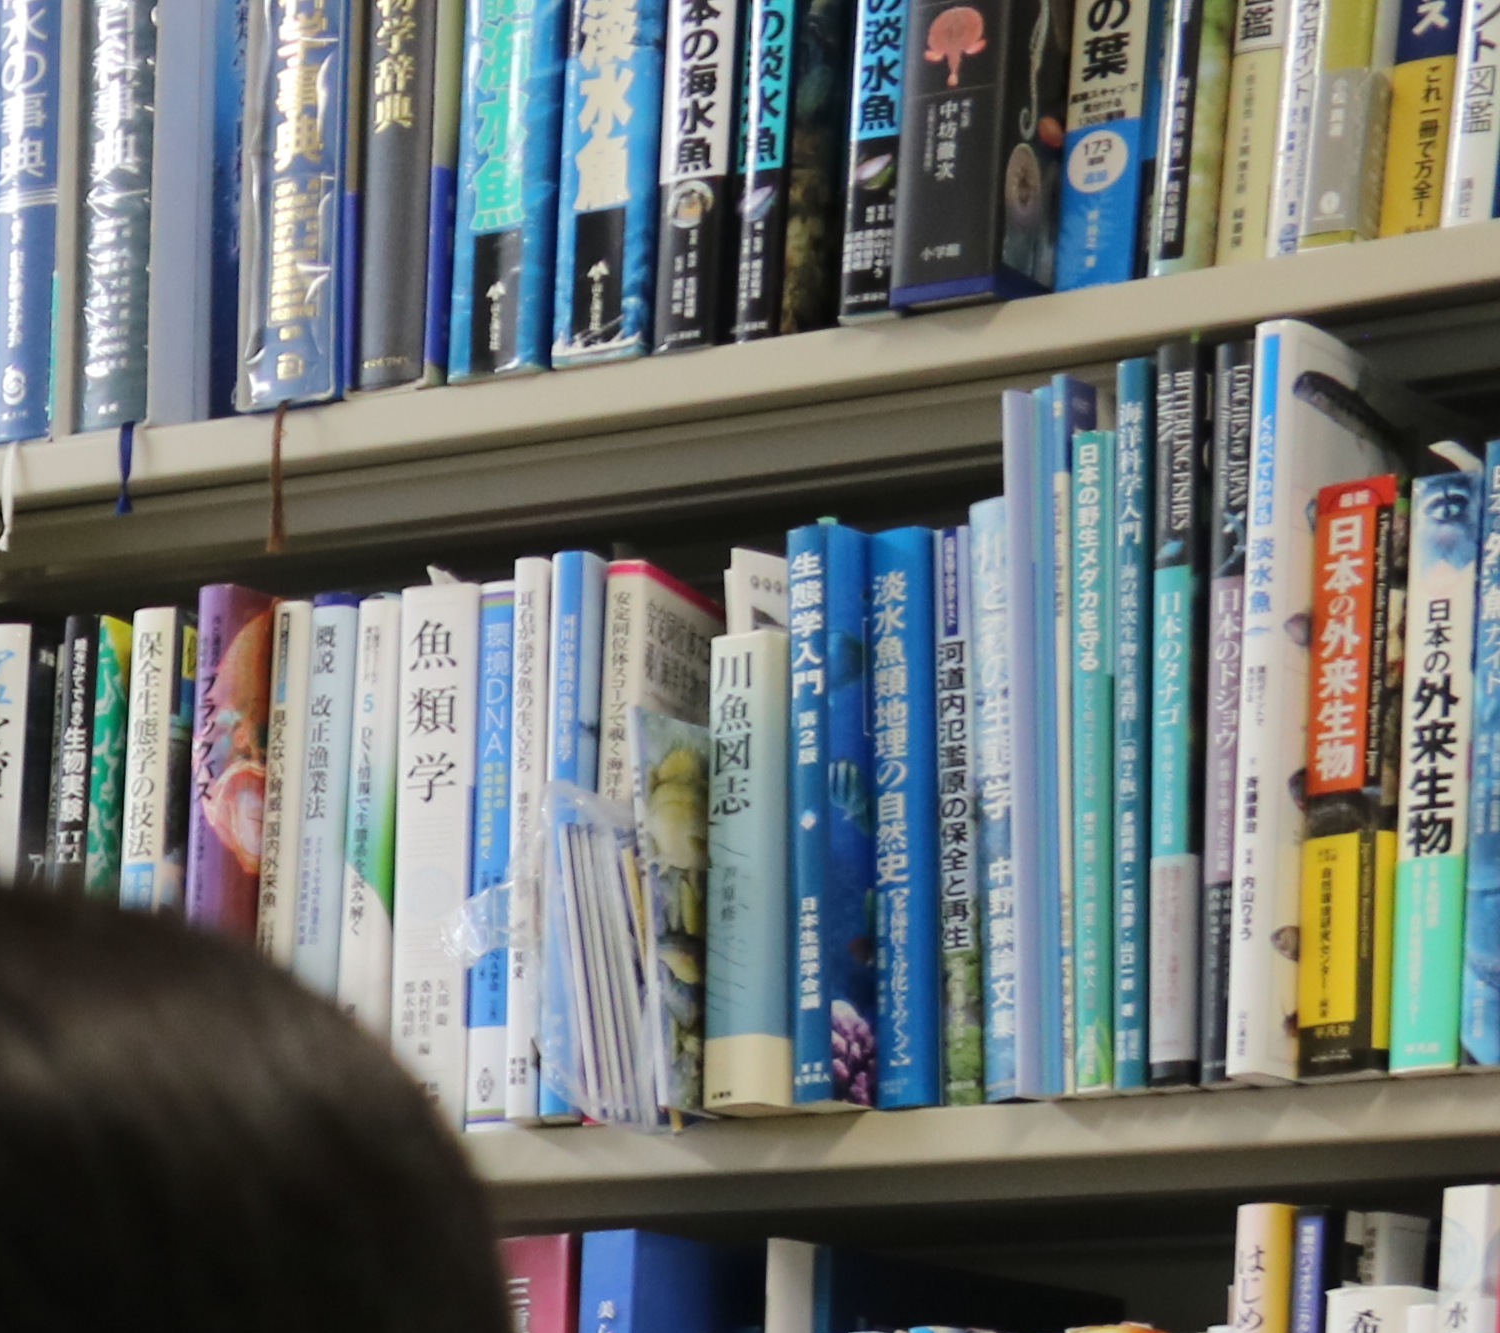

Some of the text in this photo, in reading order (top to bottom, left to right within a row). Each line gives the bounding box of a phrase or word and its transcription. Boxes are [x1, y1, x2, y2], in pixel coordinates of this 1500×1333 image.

[674, 0, 721, 173] 本の海水魚
[1082, 0, 1131, 82] の葉
[1083, 139, 1113, 156] 173
[920, 242, 962, 263] 小学館
[1115, 400, 1145, 549] 海洋科学入門
[1156, 391, 1174, 443] JAPAN
[1170, 371, 1195, 531] BITTERLING FISHES
[1228, 364, 1252, 507] LOACHES JAPAN
[1077, 443, 1102, 673] 日本の野生メダカを守る
[1249, 537, 1276, 614] 淡水魚
[312, 624, 338, 676] 概説
[363, 693, 375, 715] 5
[406, 620, 458, 804] 魚類学
[484, 622, 513, 758] 環境DNA
[791, 551, 824, 766] 生態学入門 第2版
[1156, 590, 1182, 728] 日本のタナゴ
[1213, 588, 1241, 751] 日本のドジョウ
[1315, 514, 1367, 783] 日本の外来生物
[128, 631, 164, 860] 保全生態学の技法
[196, 674, 220, 803] ブラックバス
[304, 694, 333, 821] 改正漁業法
[715, 651, 753, 817] 川魚図志
[873, 570, 910, 887] 淡水魚類地理の自然史
[937, 640, 971, 951] 河道内氾濫原の保全と再生
[1408, 598, 1460, 858] 日本の外来生物
[1313, 1023, 1352, 1041] 平凡社
